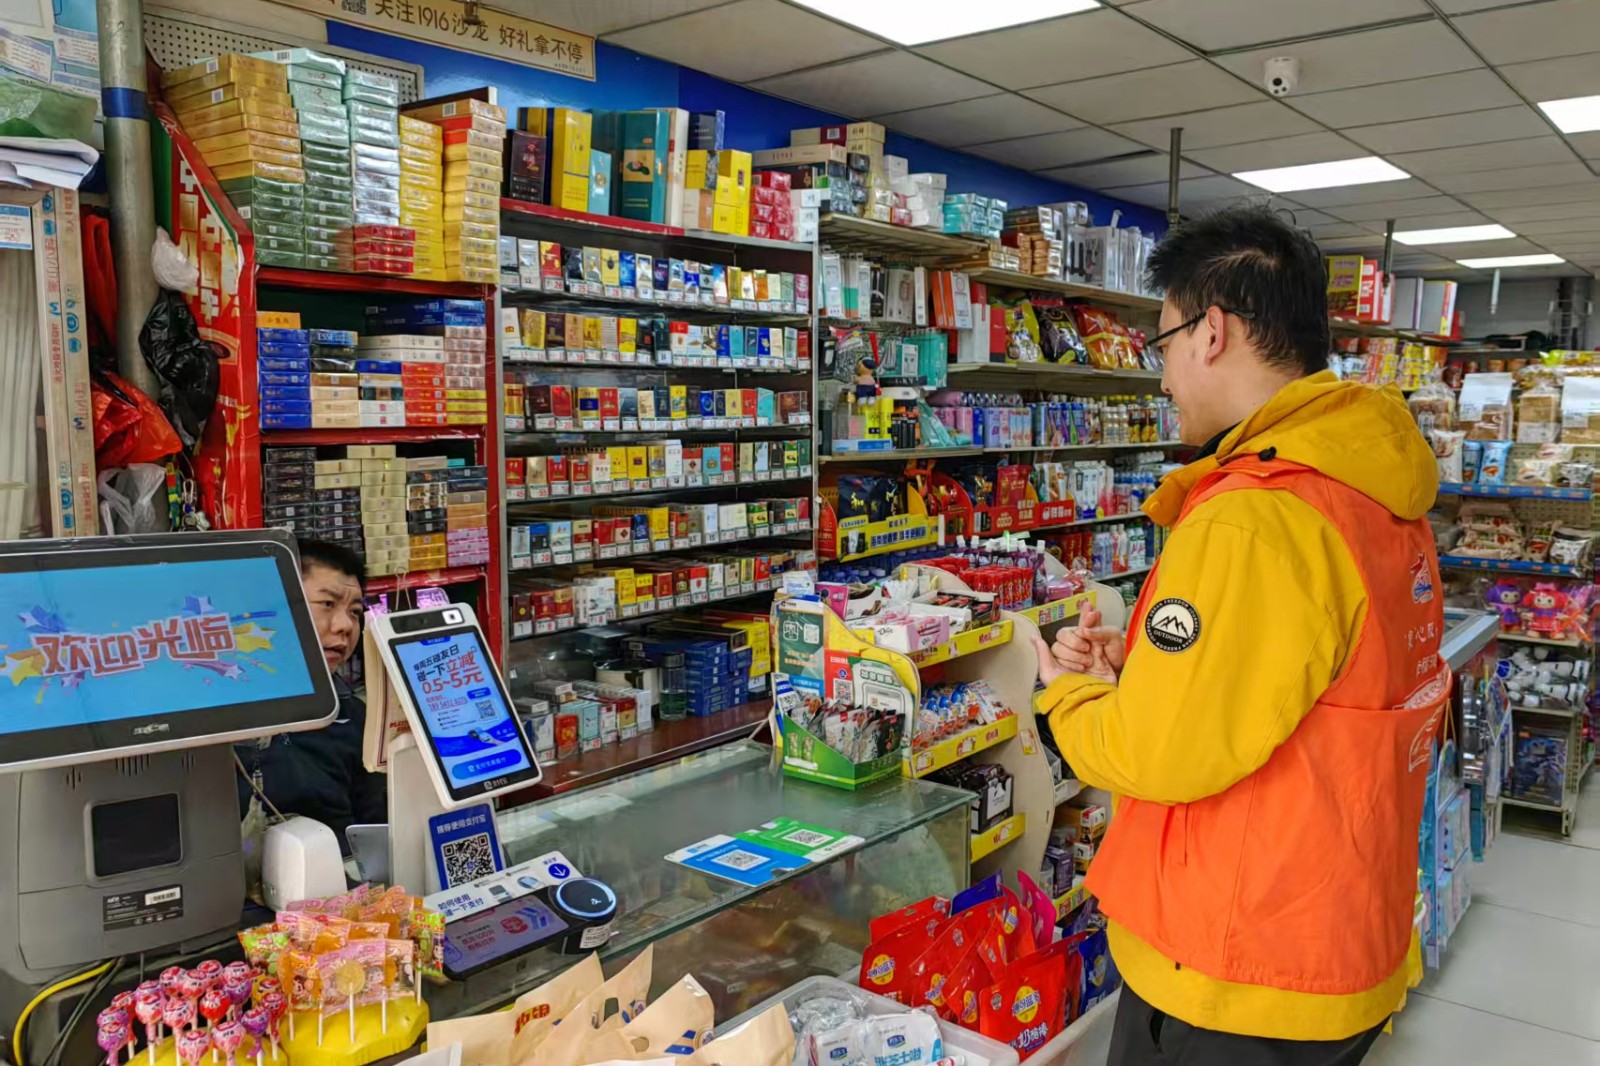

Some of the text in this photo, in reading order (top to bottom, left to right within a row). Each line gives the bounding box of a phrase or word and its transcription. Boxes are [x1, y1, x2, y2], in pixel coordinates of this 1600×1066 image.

[375, 0, 583, 64] 关注1916沙龙 好礼拿不停
[32, 613, 236, 676] 欢迎光临
[1153, 629, 1183, 643] OUTDOOR
[438, 892, 471, 910] 如何使用
